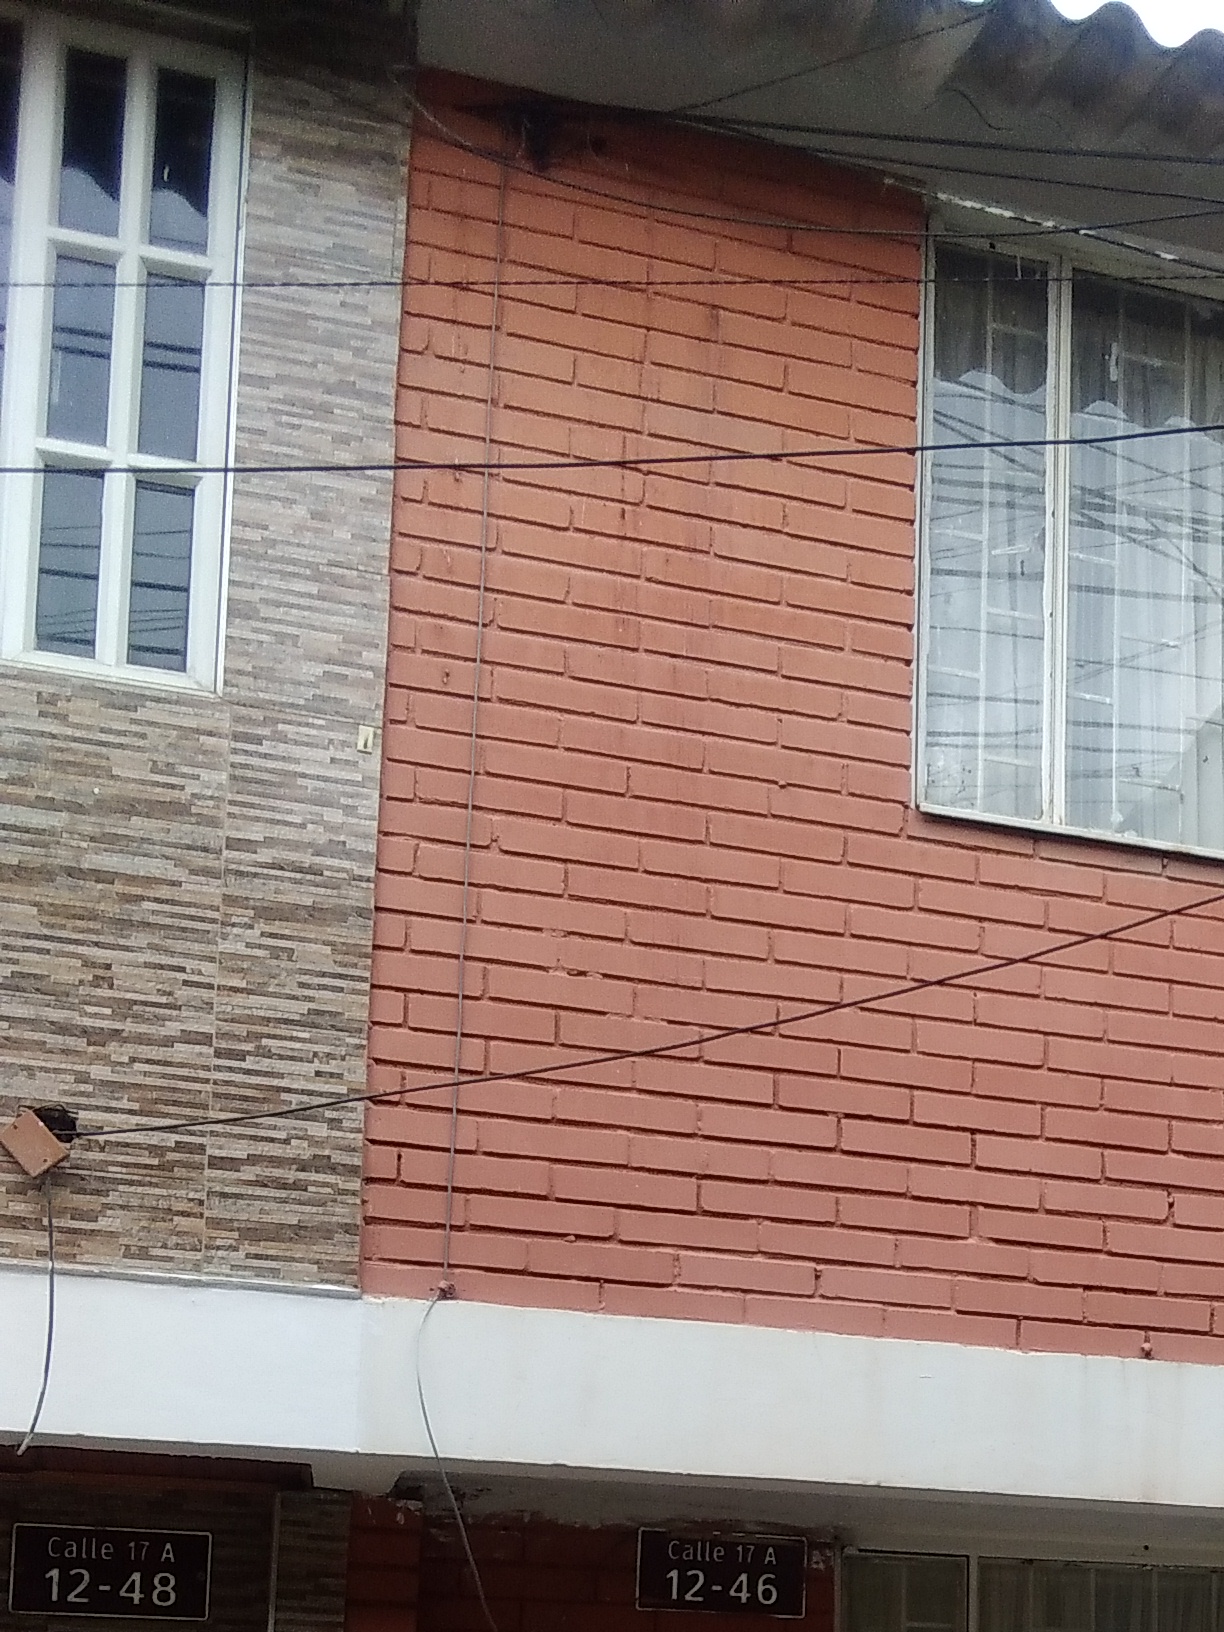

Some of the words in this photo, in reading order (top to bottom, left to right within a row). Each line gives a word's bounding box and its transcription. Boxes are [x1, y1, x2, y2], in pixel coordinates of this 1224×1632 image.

[48, 1536, 114, 1560] Calle
[128, 1541, 150, 1561] 17
[160, 1542, 175, 1563] A
[668, 1540, 725, 1562] Calle
[736, 1544, 755, 1563] 17
[764, 1546, 777, 1565] A
[45, 1567, 177, 1607] 12-48
[666, 1568, 778, 1605] 12-46
